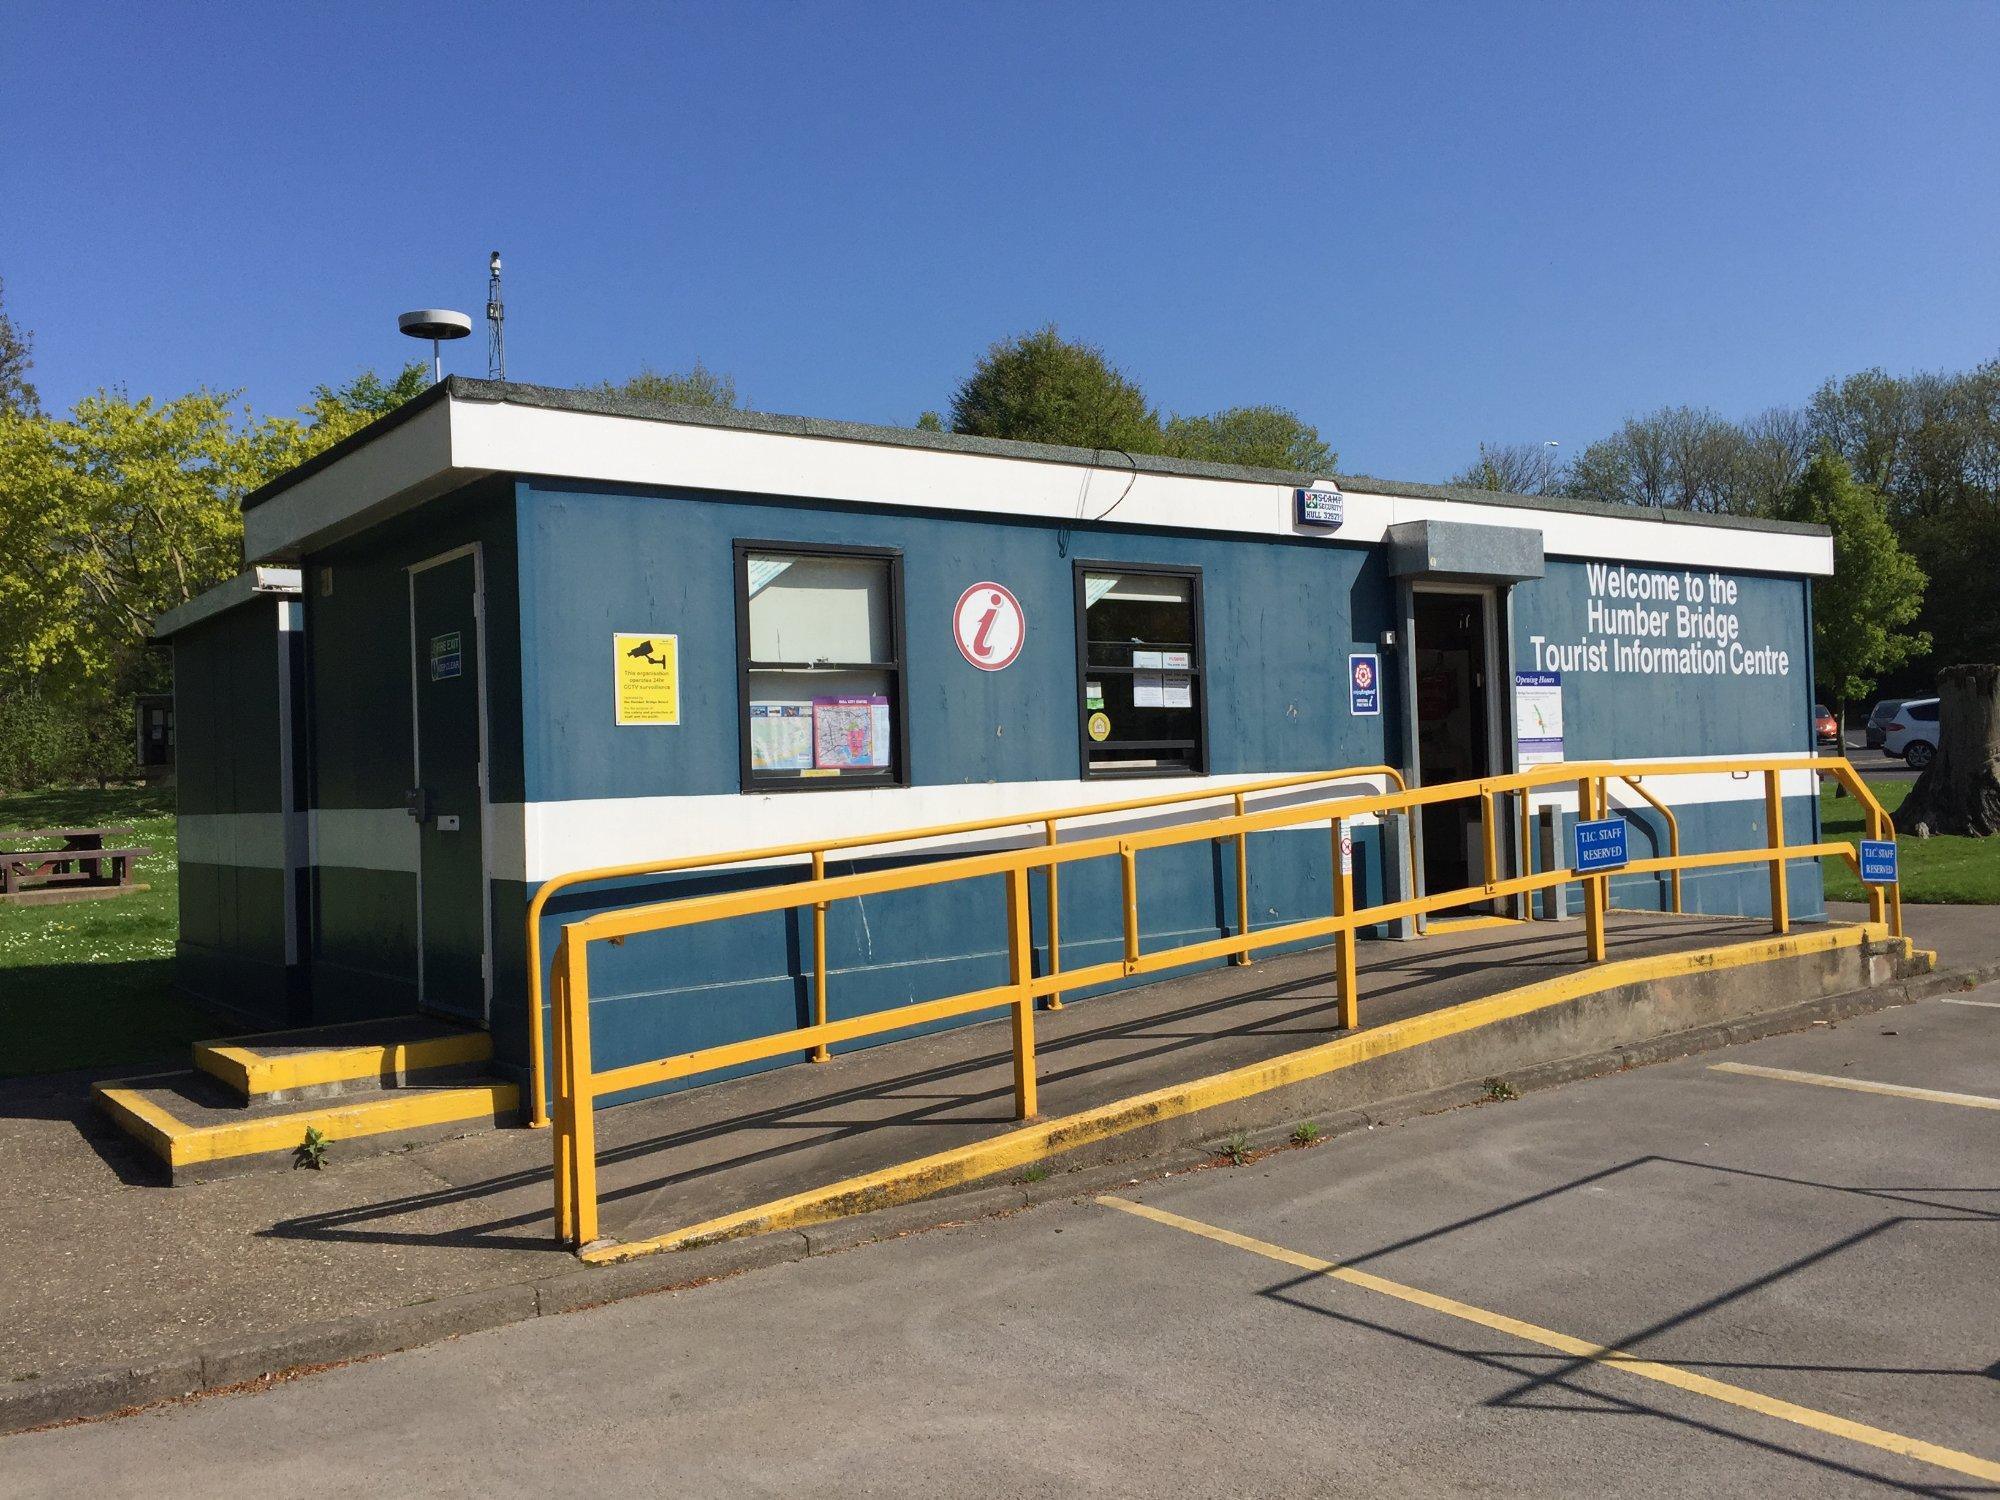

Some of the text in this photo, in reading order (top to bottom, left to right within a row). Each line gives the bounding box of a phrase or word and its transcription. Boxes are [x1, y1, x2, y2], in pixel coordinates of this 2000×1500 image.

[1318, 503, 1342, 511] SECURITY
[1306, 510, 1322, 519] HULL
[1586, 562, 1738, 605] Welcome to the
[1587, 599, 1739, 648] Humber Bridge
[1530, 636, 1789, 676] Tourist Information Centre
[1515, 675, 1555, 685] Opening Hours
[1598, 827, 1623, 841] STAFF
[1583, 845, 1623, 861] RESERVED
[1878, 848, 1894, 859] STAFF
[1865, 864, 1894, 875] RESERVED
